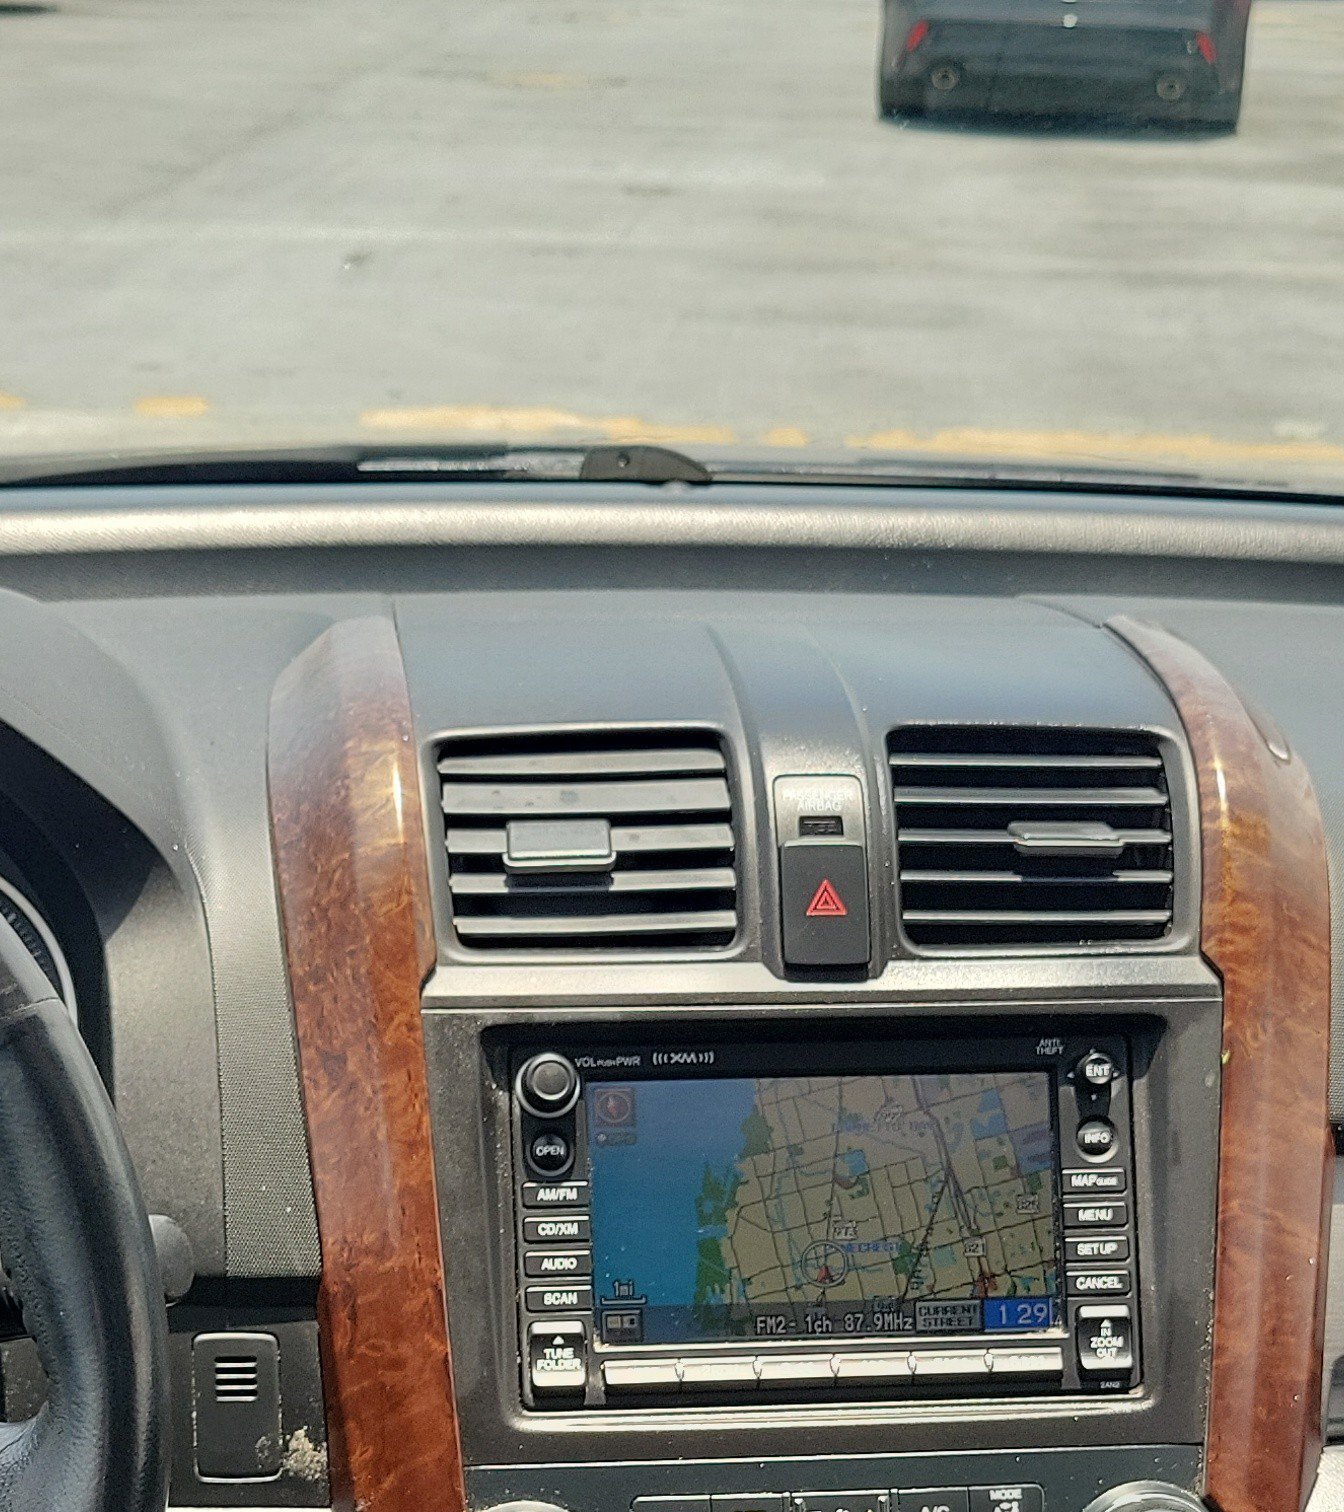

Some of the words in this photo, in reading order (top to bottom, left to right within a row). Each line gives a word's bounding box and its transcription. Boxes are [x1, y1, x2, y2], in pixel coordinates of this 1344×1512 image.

[797, 800, 841, 812] AIRBAG
[1036, 1046, 1063, 1055] THEFT
[575, 1057, 596, 1068] VOL
[616, 1056, 641, 1067] PWR
[1085, 1065, 1111, 1078] ENT
[1084, 1132, 1111, 1144] INFO
[536, 1145, 565, 1157] OPEN
[1071, 1173, 1097, 1187] MAP
[537, 1188, 578, 1202] AM/FM
[1078, 1208, 1113, 1222] MENU
[537, 1223, 579, 1237] CD/XM
[541, 1257, 578, 1271] AUDIO
[1076, 1276, 1123, 1290] CANCEL
[543, 1291, 578, 1305] SCAN
[918, 1303, 978, 1316] CURRENT
[921, 1315, 974, 1328] STREET
[1100, 1326, 1112, 1336] IN
[1090, 1336, 1124, 1348] ZOOM
[543, 1347, 575, 1360] TUNE
[1096, 1347, 1118, 1358] OUT
[535, 1359, 582, 1371] FOLDER
[989, 1488, 1022, 1501] MODE
